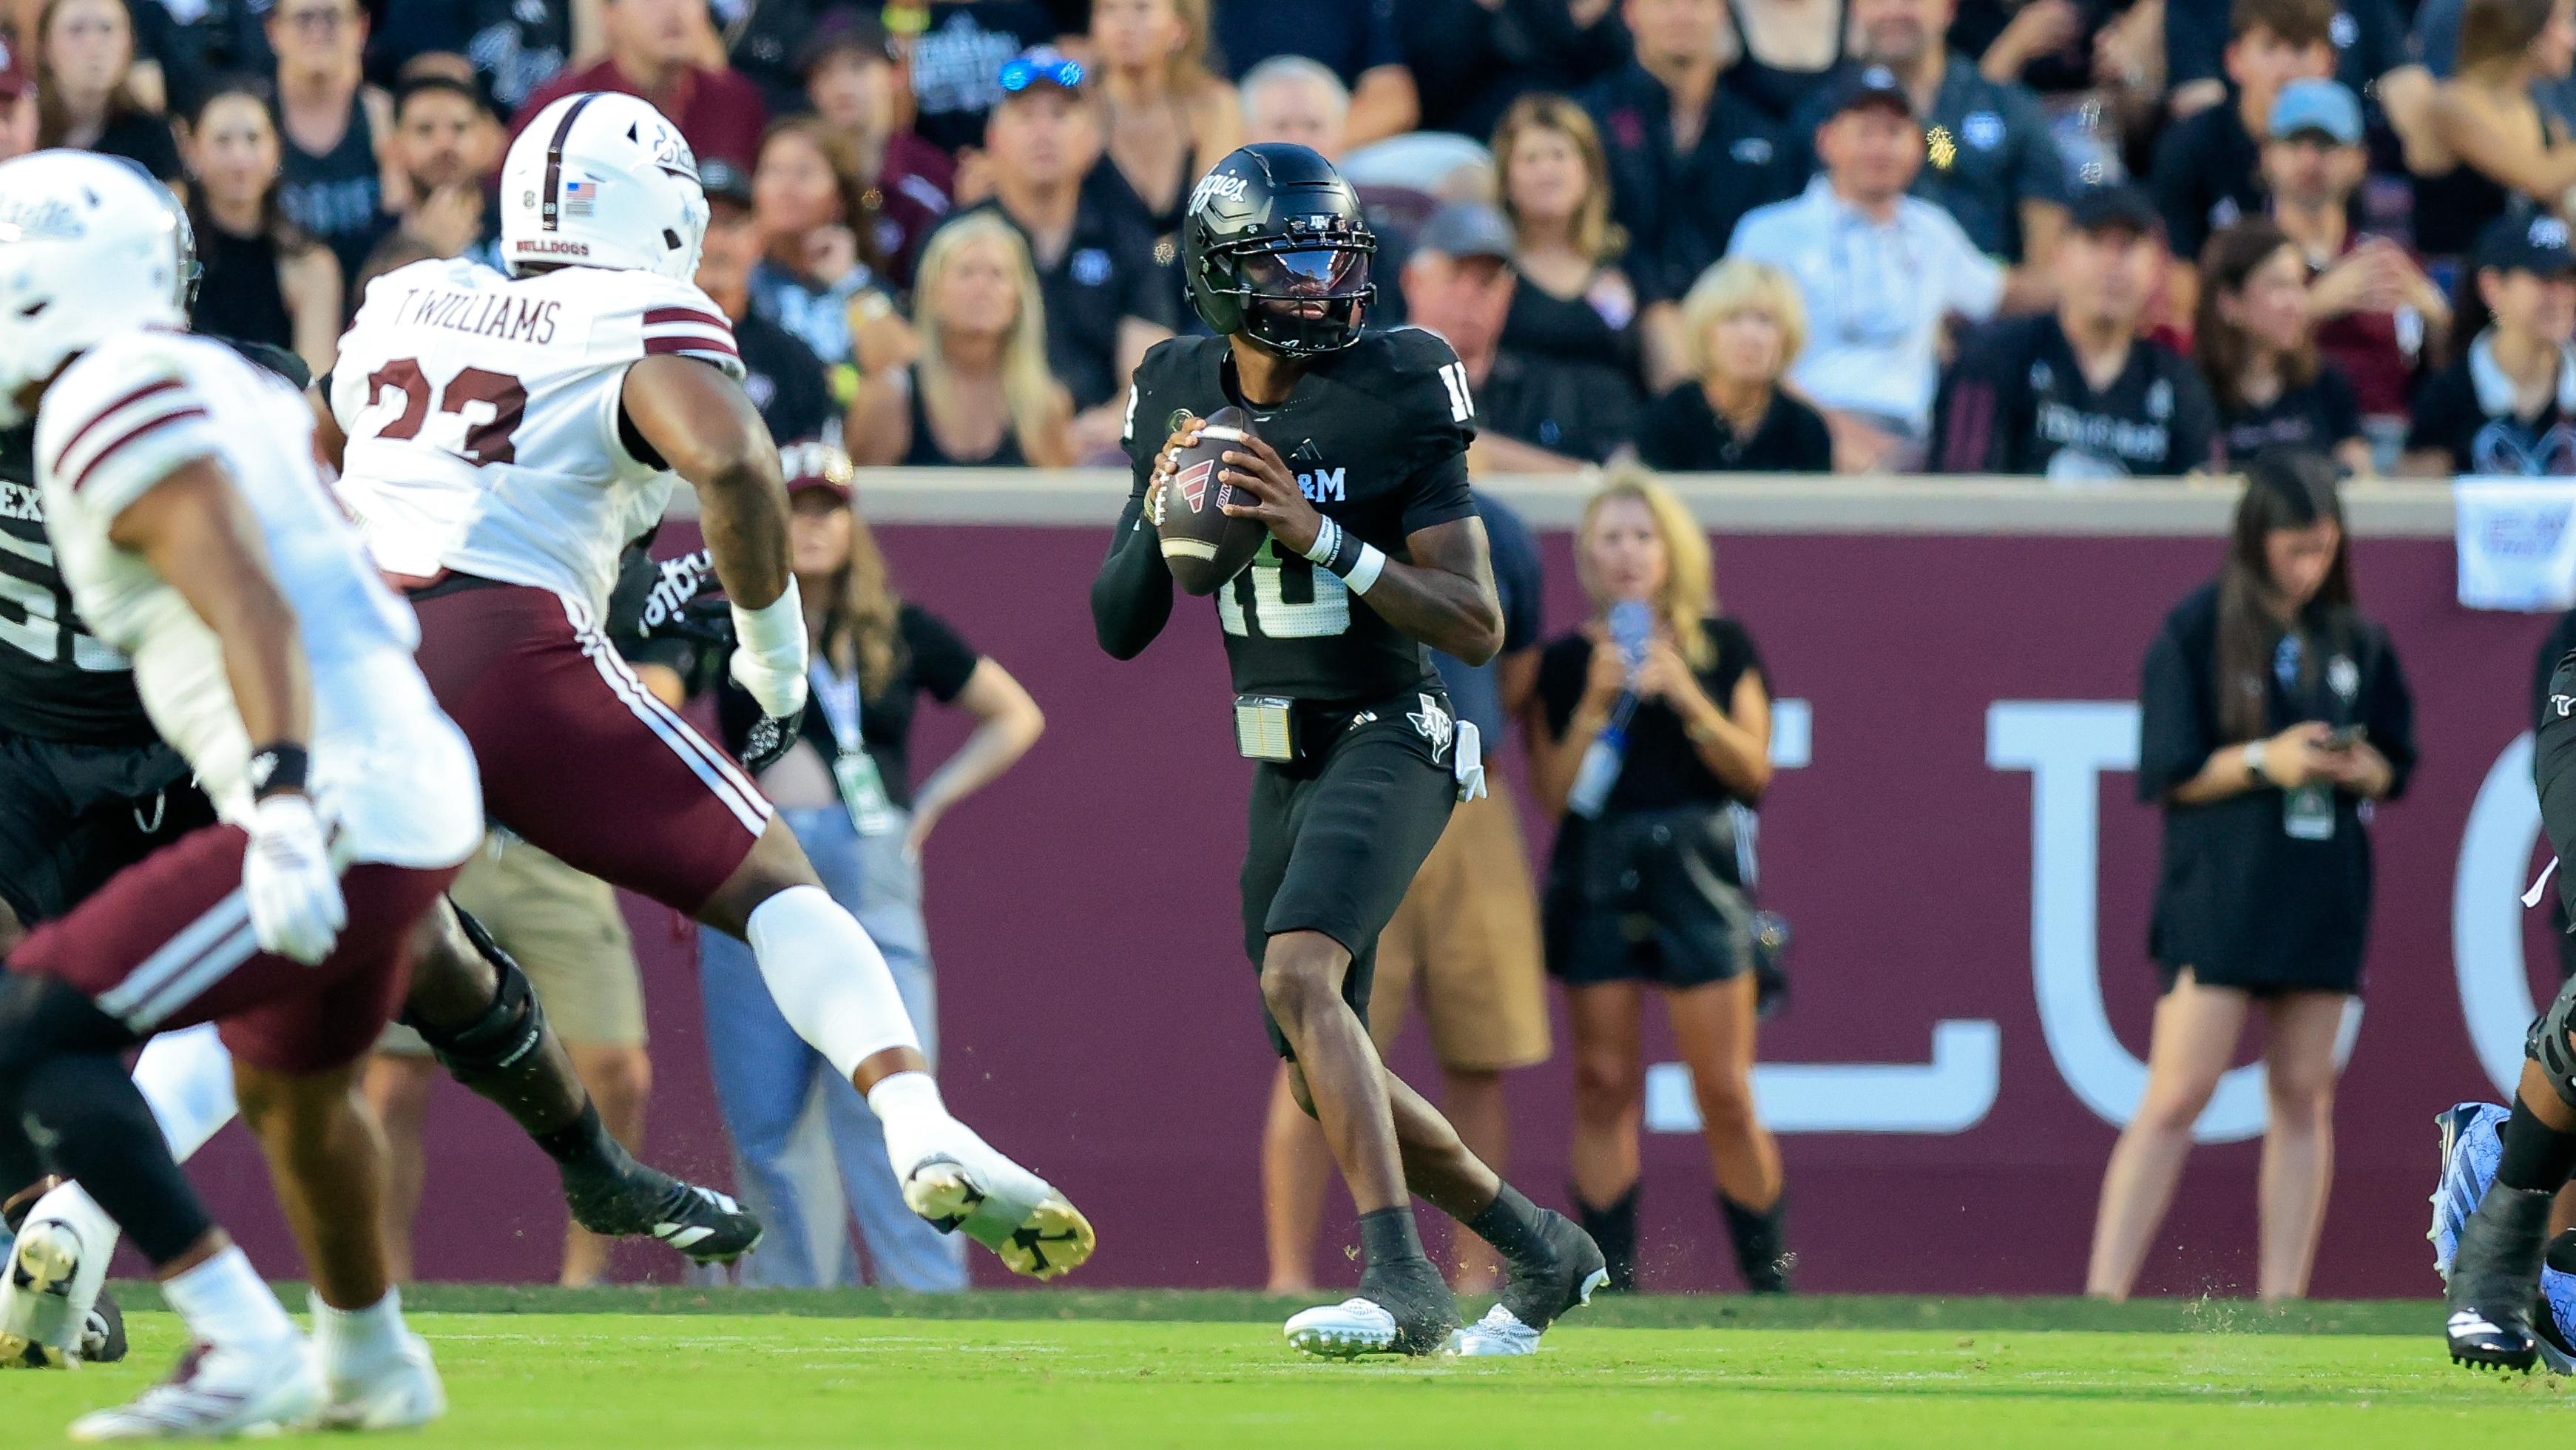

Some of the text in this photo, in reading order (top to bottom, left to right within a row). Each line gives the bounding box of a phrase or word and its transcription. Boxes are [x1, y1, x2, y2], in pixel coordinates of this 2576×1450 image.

[516, 240, 591, 256] BULLDOGS
[368, 357, 528, 468] 23
[1289, 467, 1346, 503] &M
